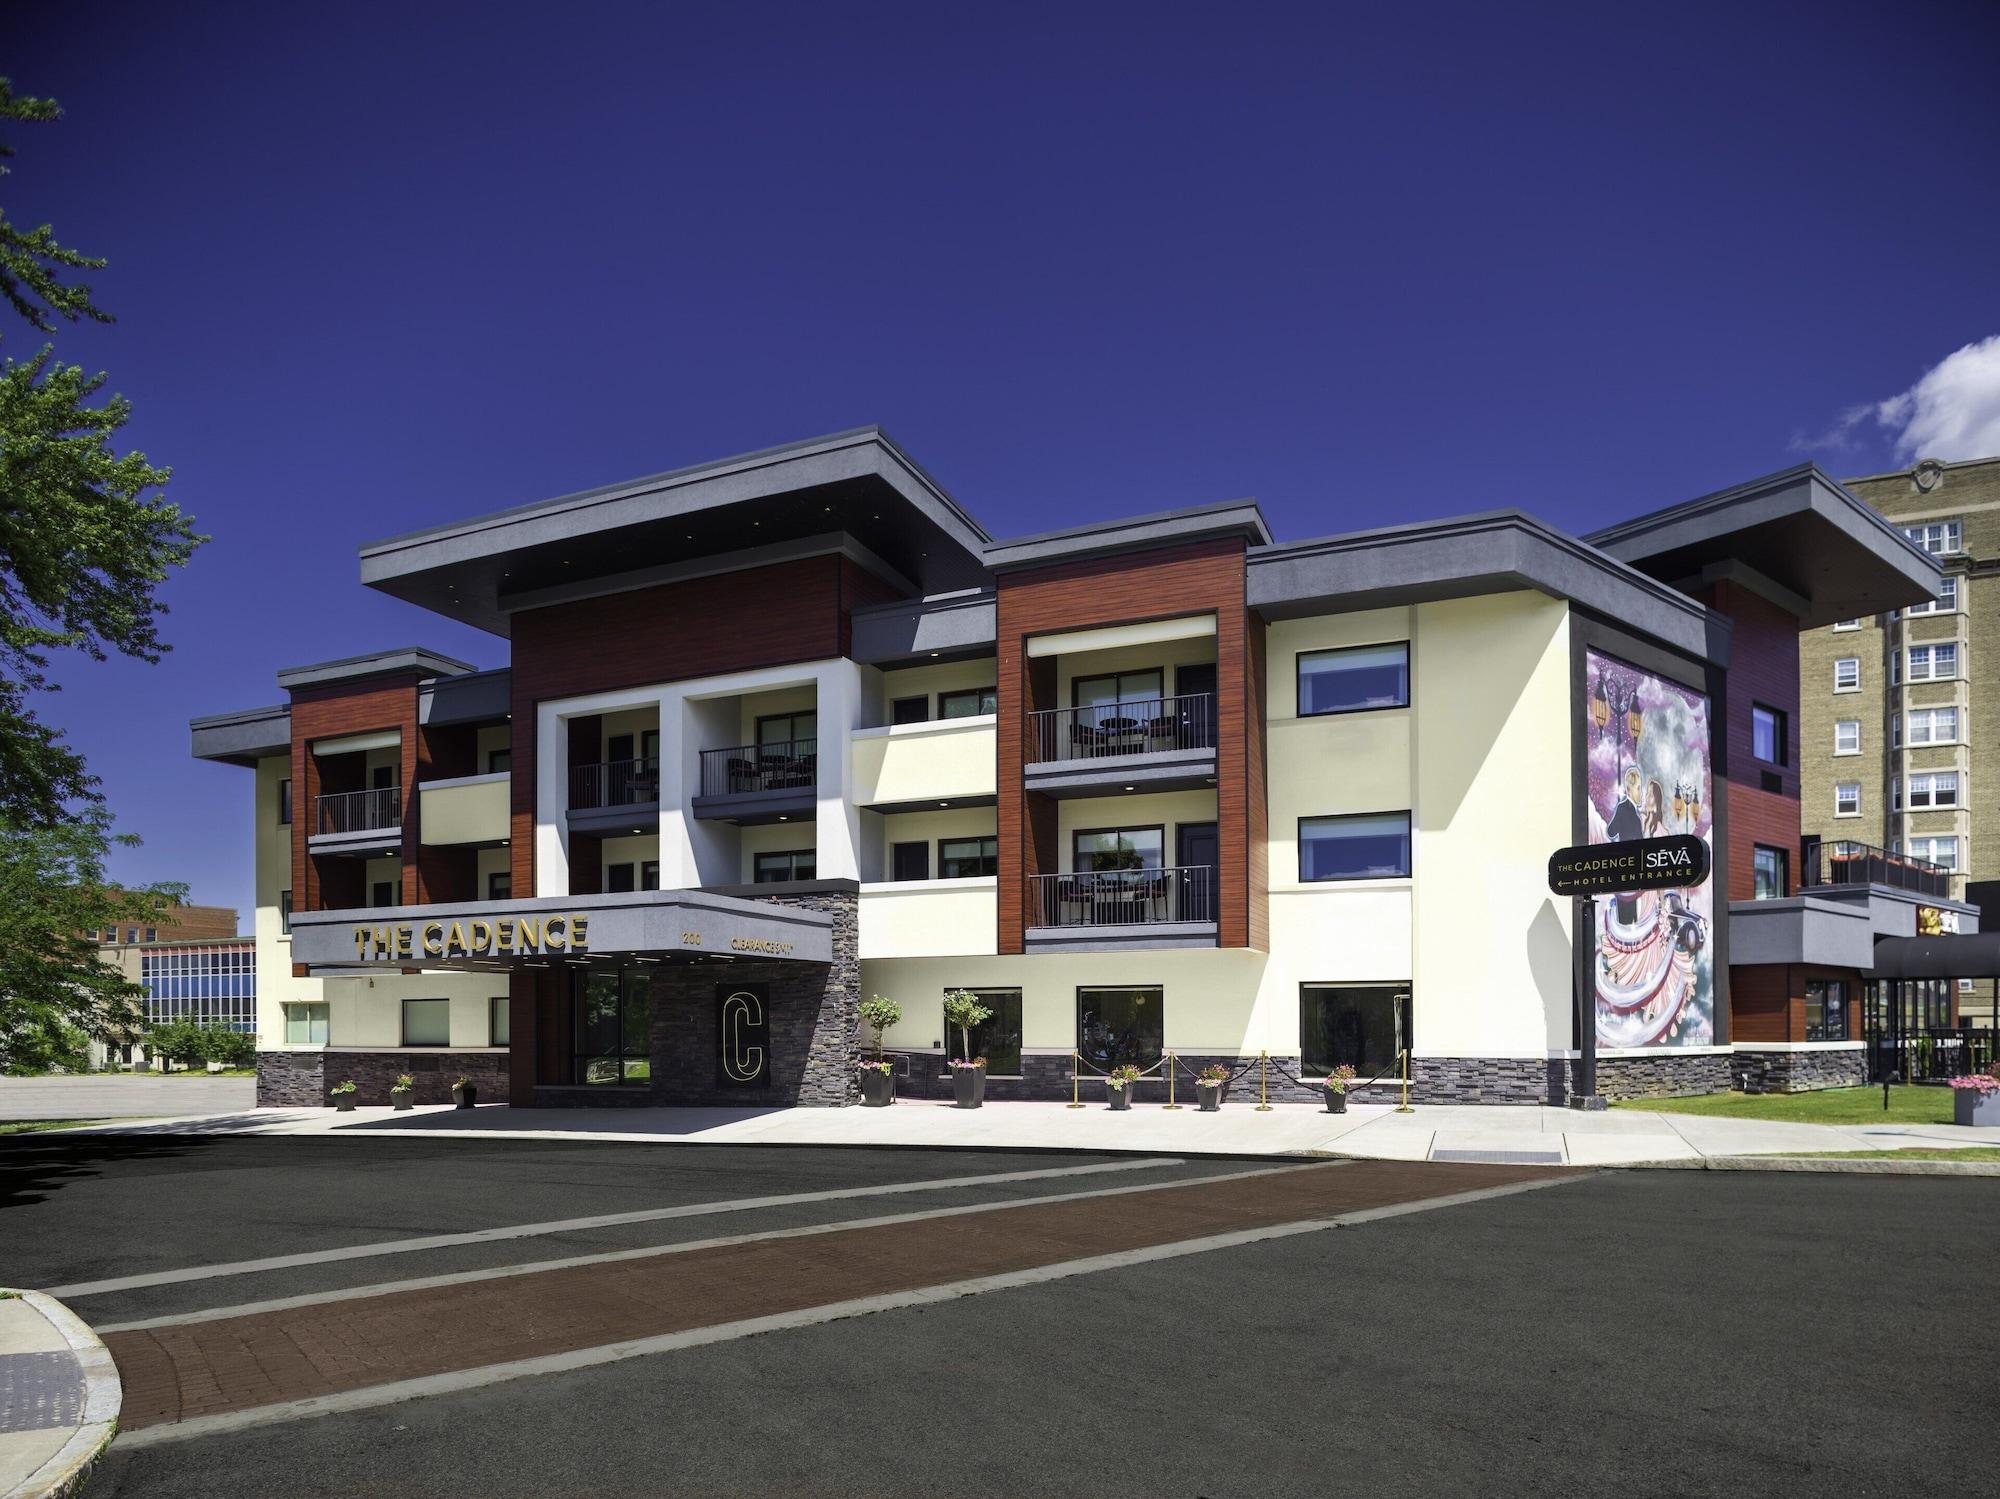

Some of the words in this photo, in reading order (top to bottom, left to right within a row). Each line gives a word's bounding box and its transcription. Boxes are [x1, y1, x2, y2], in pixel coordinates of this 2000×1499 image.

[1558, 864, 1573, 872] THE
[1574, 856, 1635, 872] CADENCE
[1573, 874, 1613, 886] HOTEL
[1620, 868, 1692, 882] ENTRANCE
[352, 924, 413, 954] THE
[422, 914, 589, 955] CADENCE
[722, 991, 763, 1081] C
